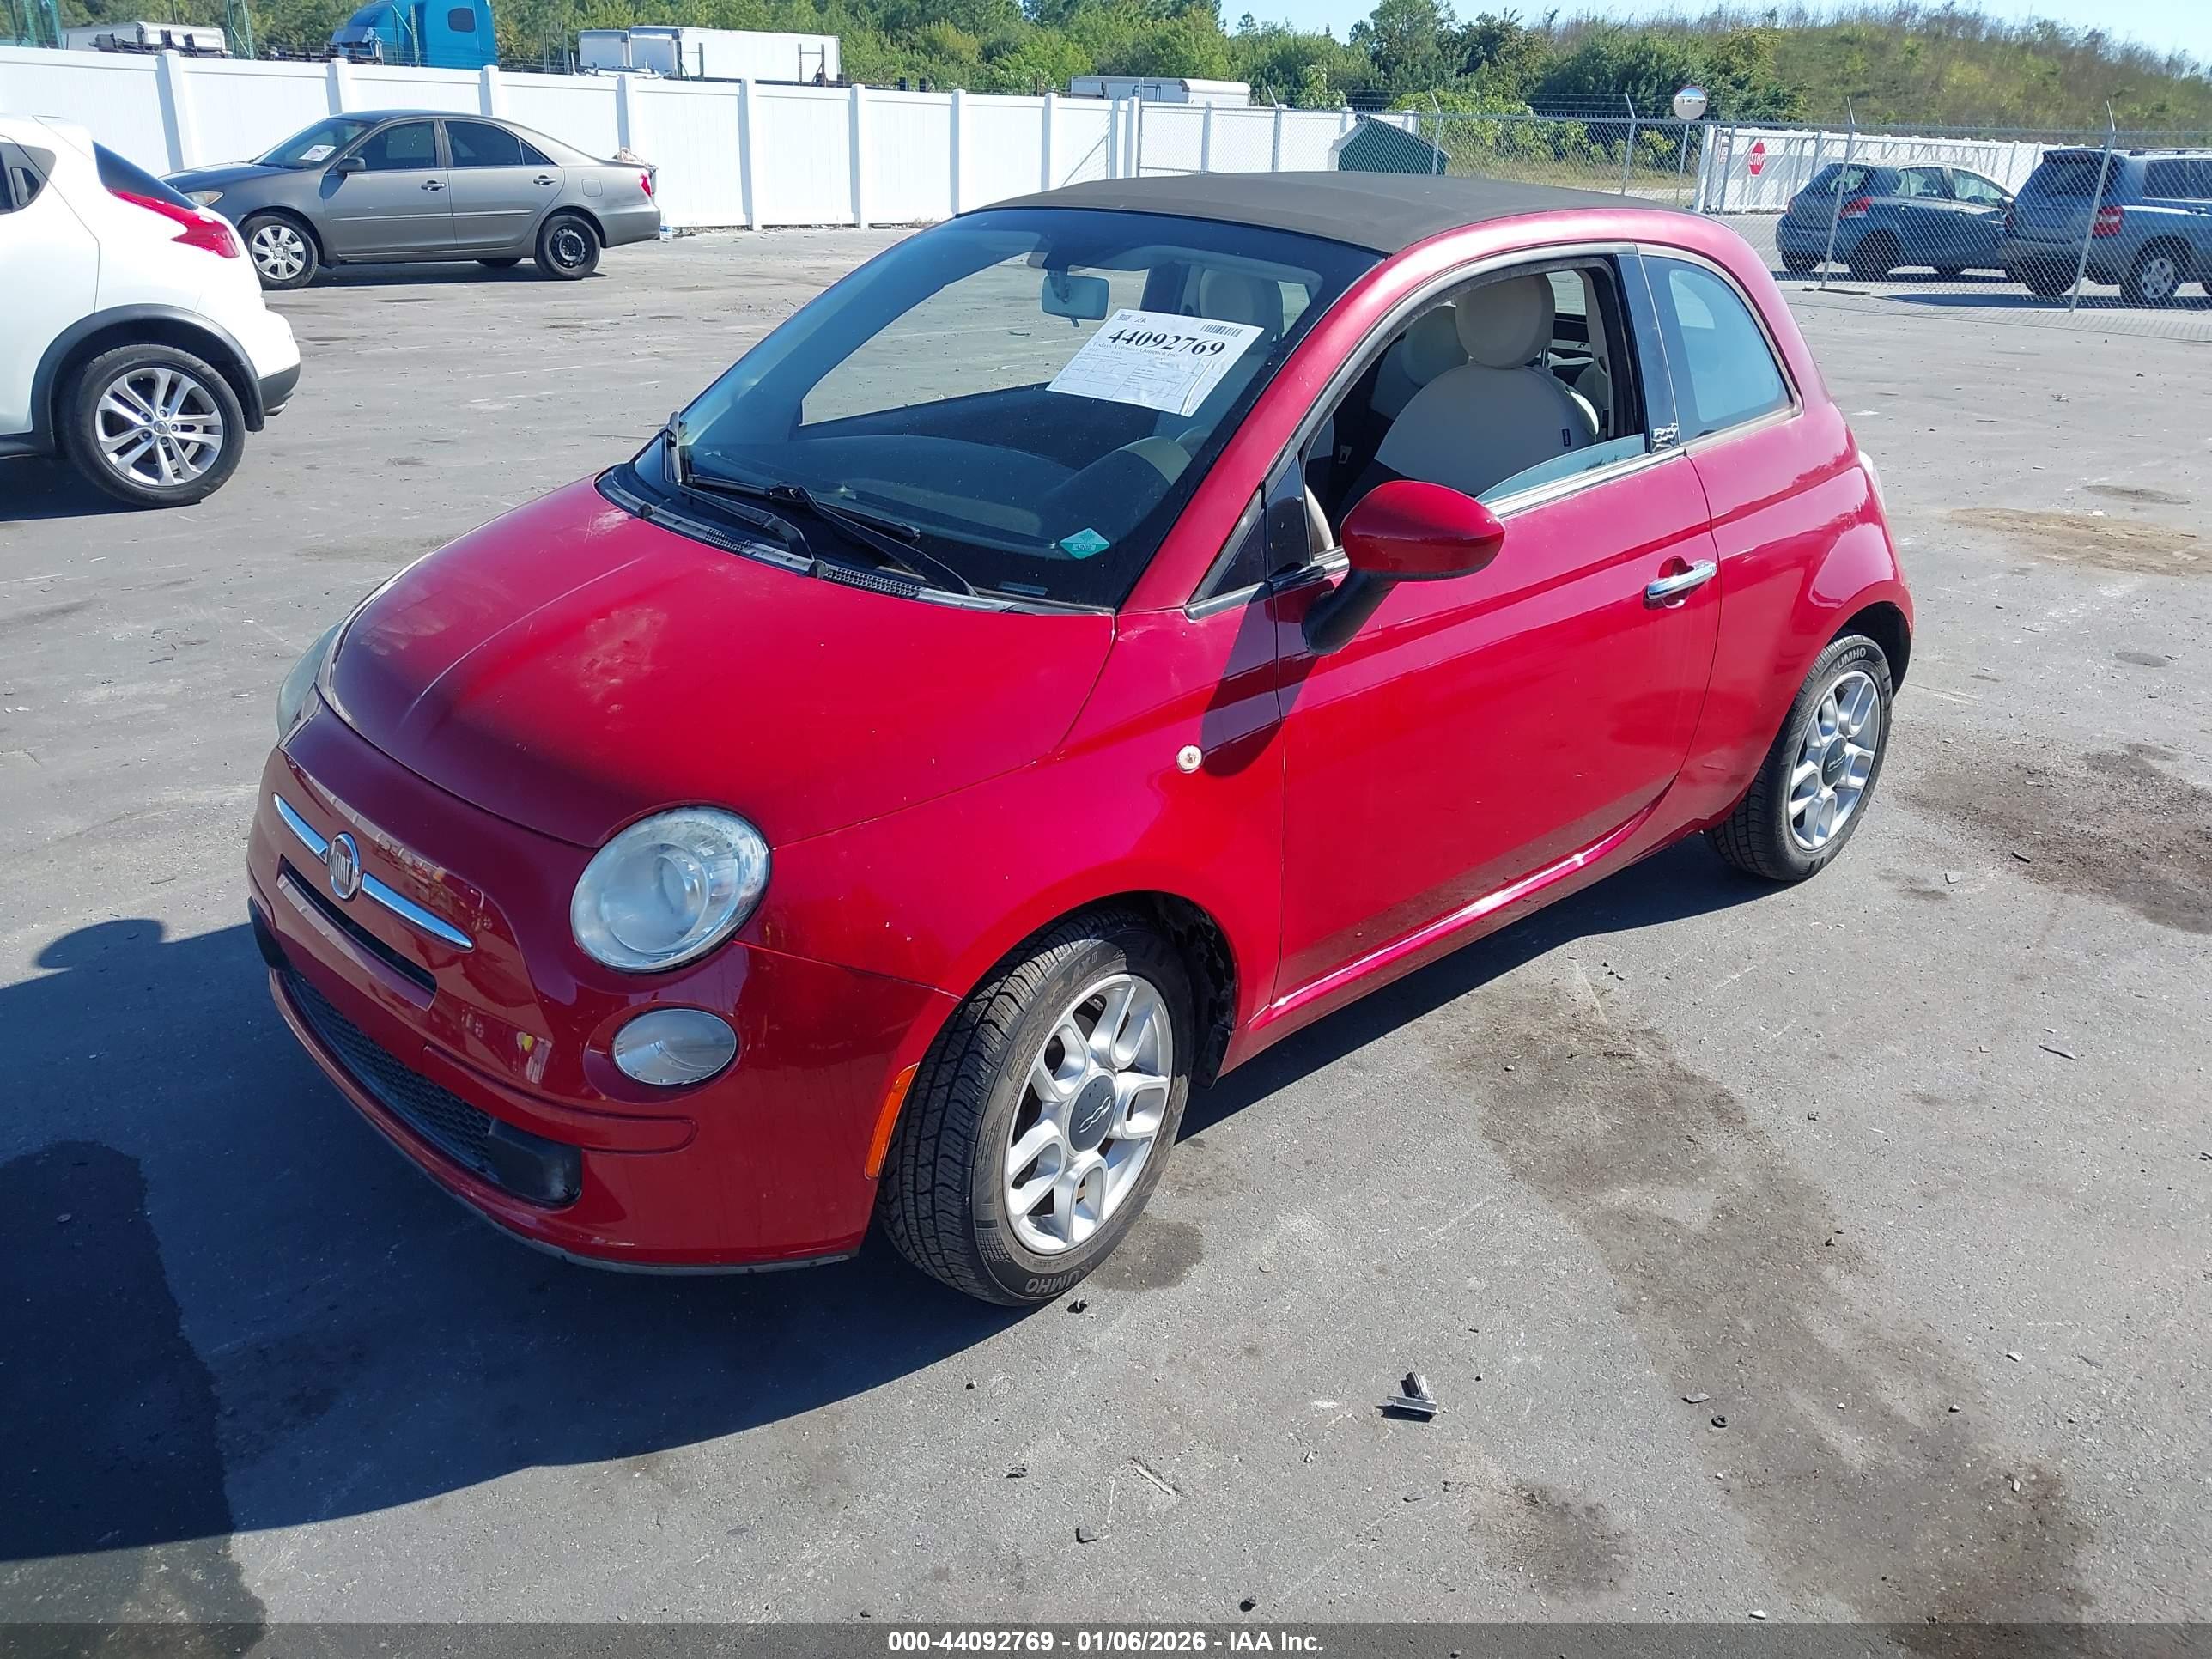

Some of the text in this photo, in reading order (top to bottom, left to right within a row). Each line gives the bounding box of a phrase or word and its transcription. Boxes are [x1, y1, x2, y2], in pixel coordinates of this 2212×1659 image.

[1749, 152, 1765, 167] STOP
[1108, 328, 1226, 356] 44092769
[1829, 647, 1867, 677] KUMHO
[334, 850, 352, 886] FIAT
[1024, 1261, 1093, 1294] KUMHO
